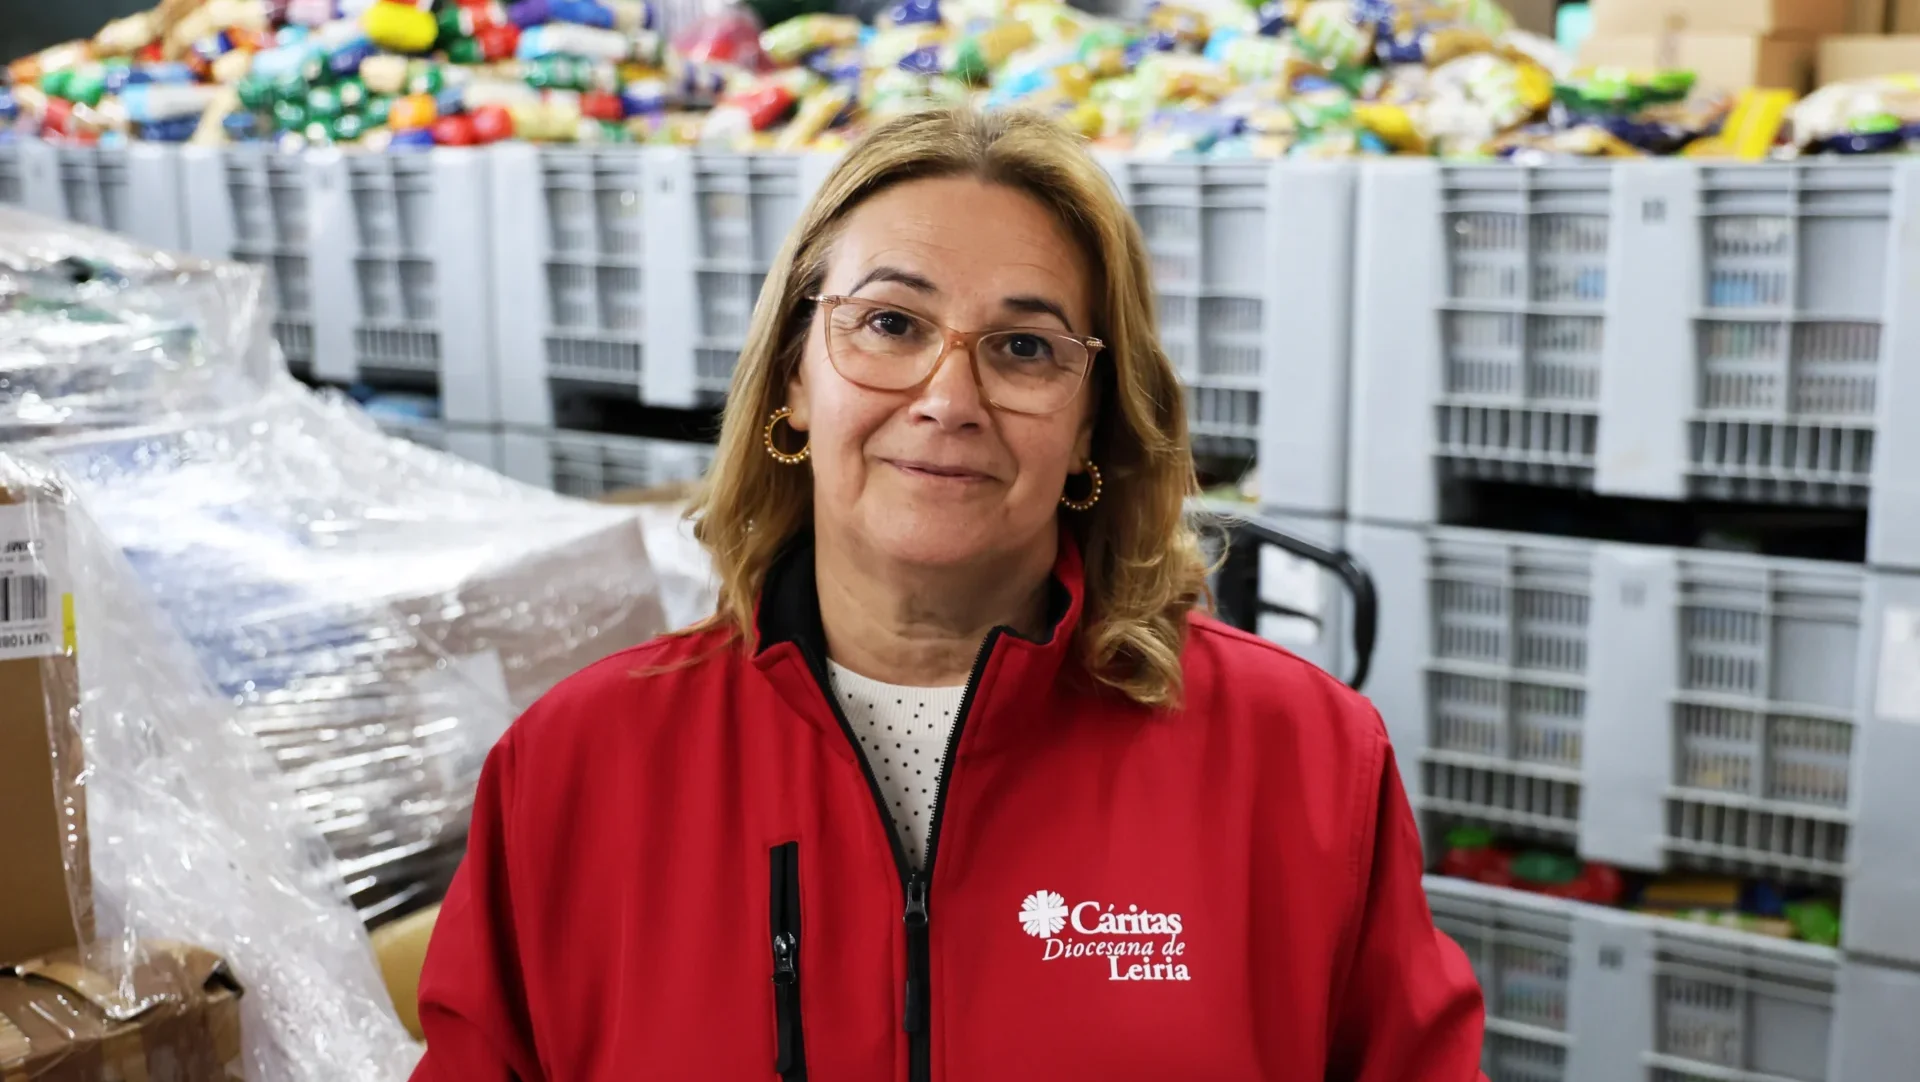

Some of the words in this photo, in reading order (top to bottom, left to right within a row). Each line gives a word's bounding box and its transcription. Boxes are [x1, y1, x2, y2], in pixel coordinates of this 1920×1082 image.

[1070, 901, 1183, 934] Cáritas
[1042, 938, 1154, 960] Diocesana
[1161, 933, 1186, 956] de
[1107, 955, 1191, 981] Leiria
